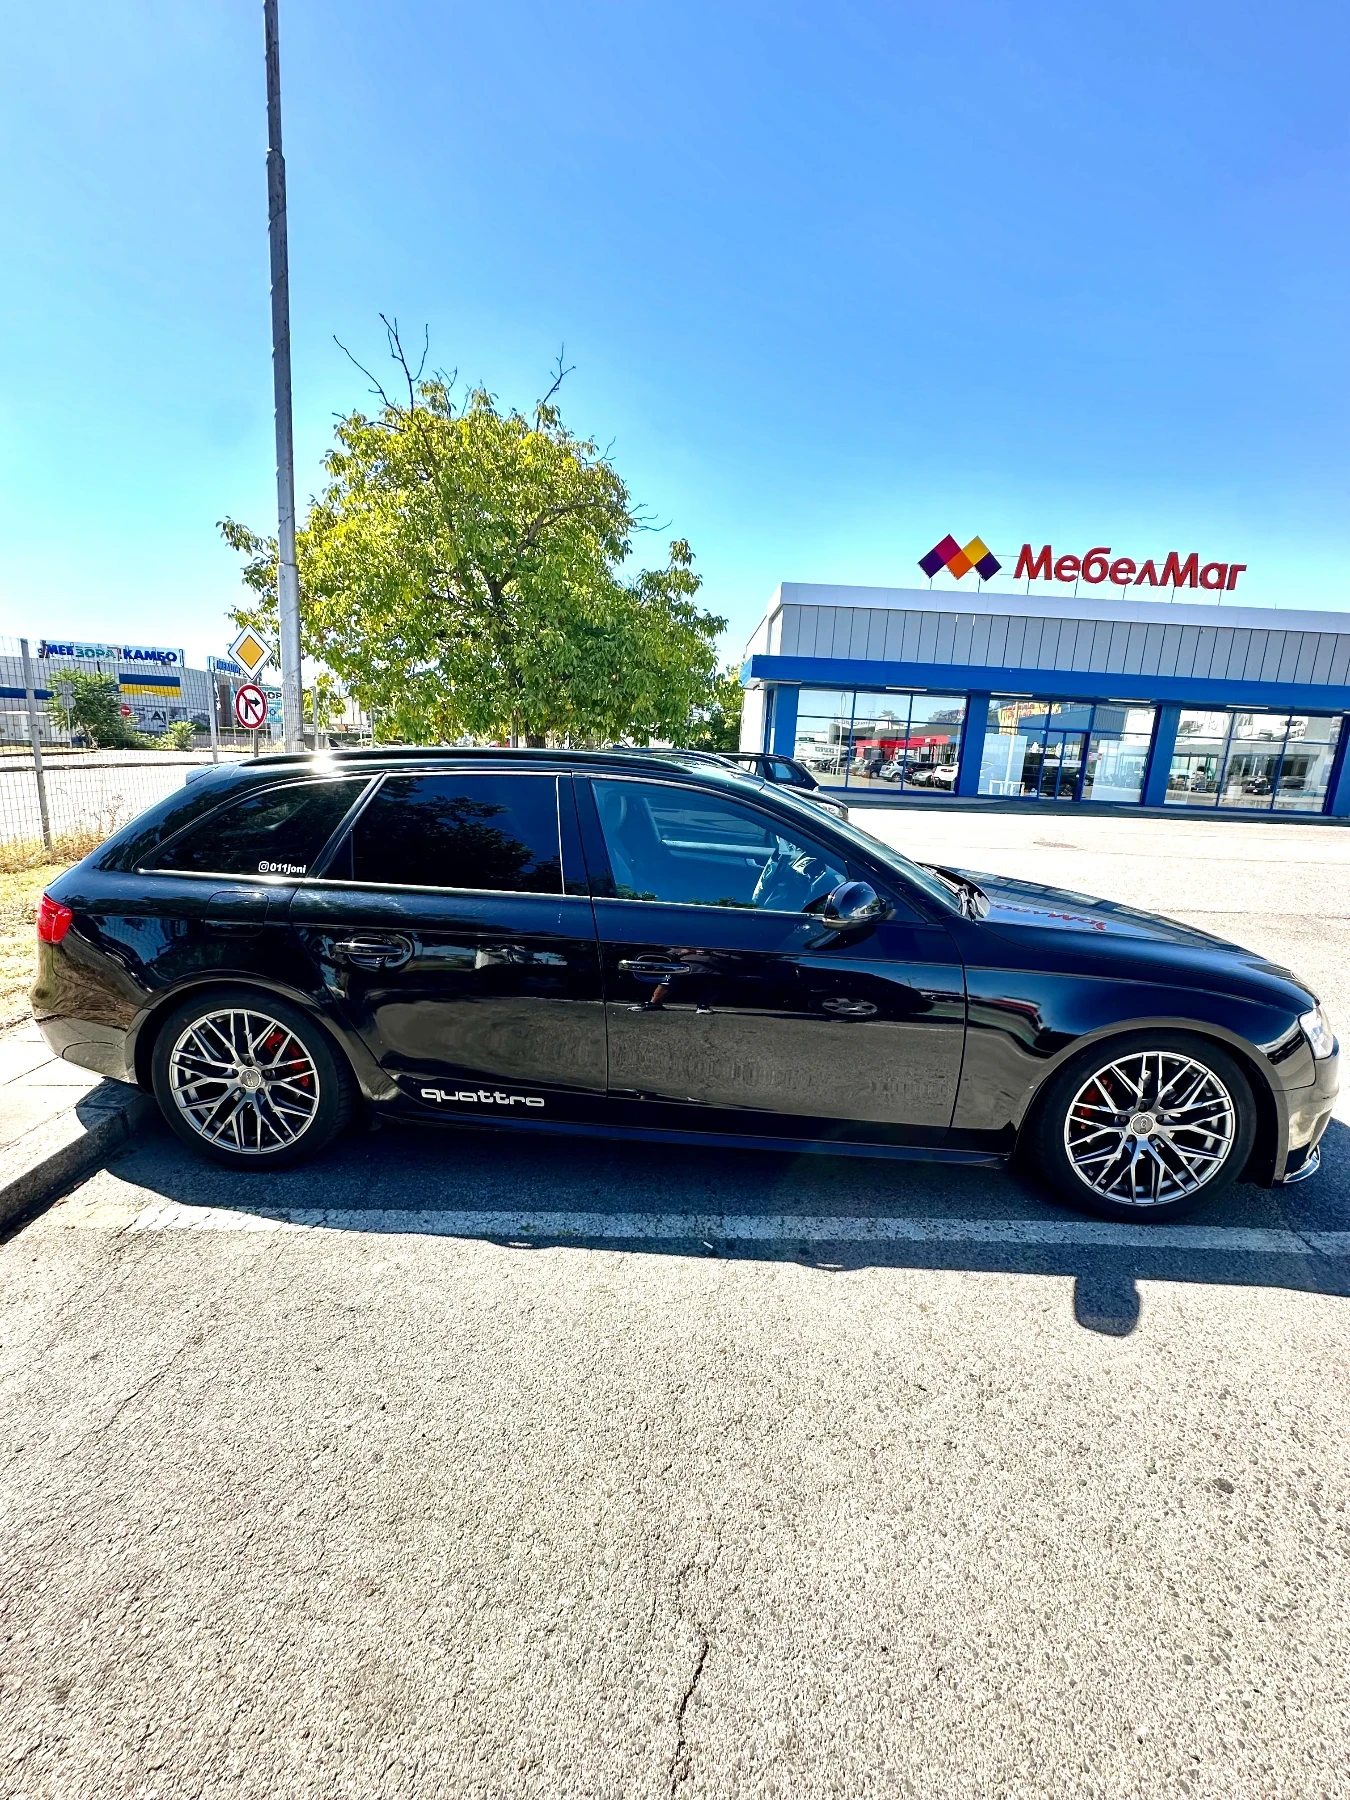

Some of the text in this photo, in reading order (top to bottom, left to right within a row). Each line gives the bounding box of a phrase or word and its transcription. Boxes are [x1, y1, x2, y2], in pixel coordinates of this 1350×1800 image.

[1014, 543, 1247, 591] МебелМаг
[75, 647, 117, 659] ЗОРА
[123, 649, 178, 662] КАМБО
[270, 862, 307, 875] 011joni
[420, 1087, 545, 1108] quattro
